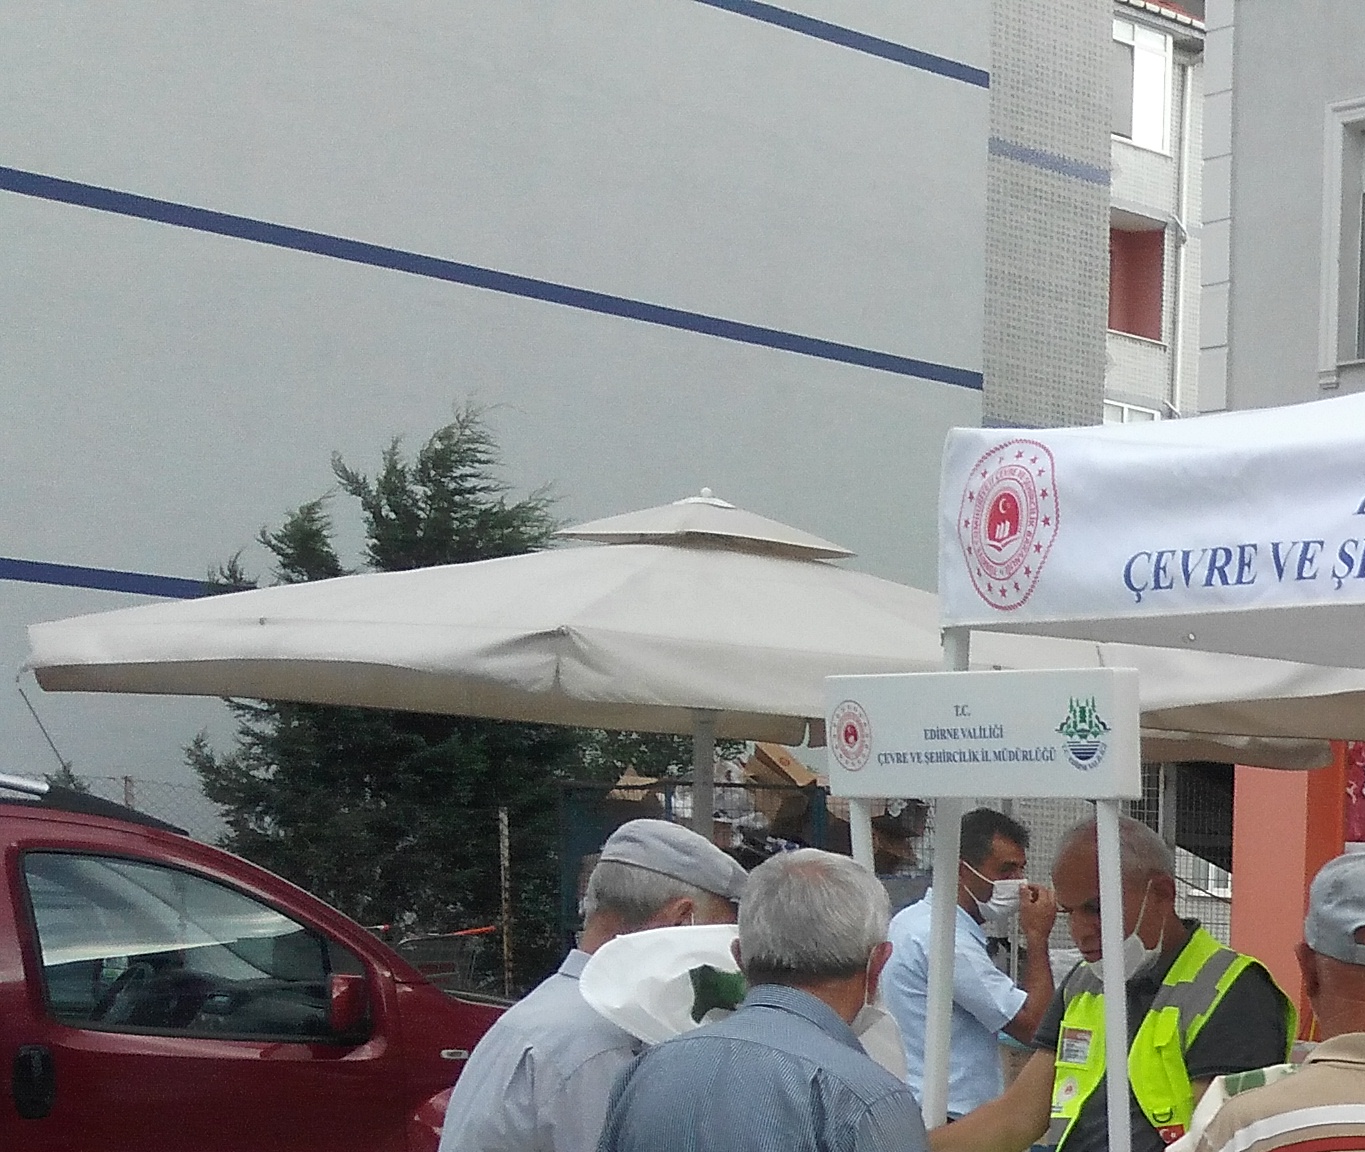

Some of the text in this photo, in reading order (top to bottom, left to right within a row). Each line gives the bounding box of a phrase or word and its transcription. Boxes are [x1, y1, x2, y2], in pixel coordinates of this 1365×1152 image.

[1122, 543, 1258, 603] ÇEVRE
[1269, 539, 1325, 582] VE
[954, 705, 971, 717] T.C.
[924, 724, 1004, 741] EDİRNE VALİLİĞİ
[877, 751, 909, 767] ÇEVRE
[910, 751, 922, 765] VE
[924, 748, 980, 766] ŞEHİRCİLİK
[993, 746, 1057, 763] MÜDÜRLÜĞÜ
